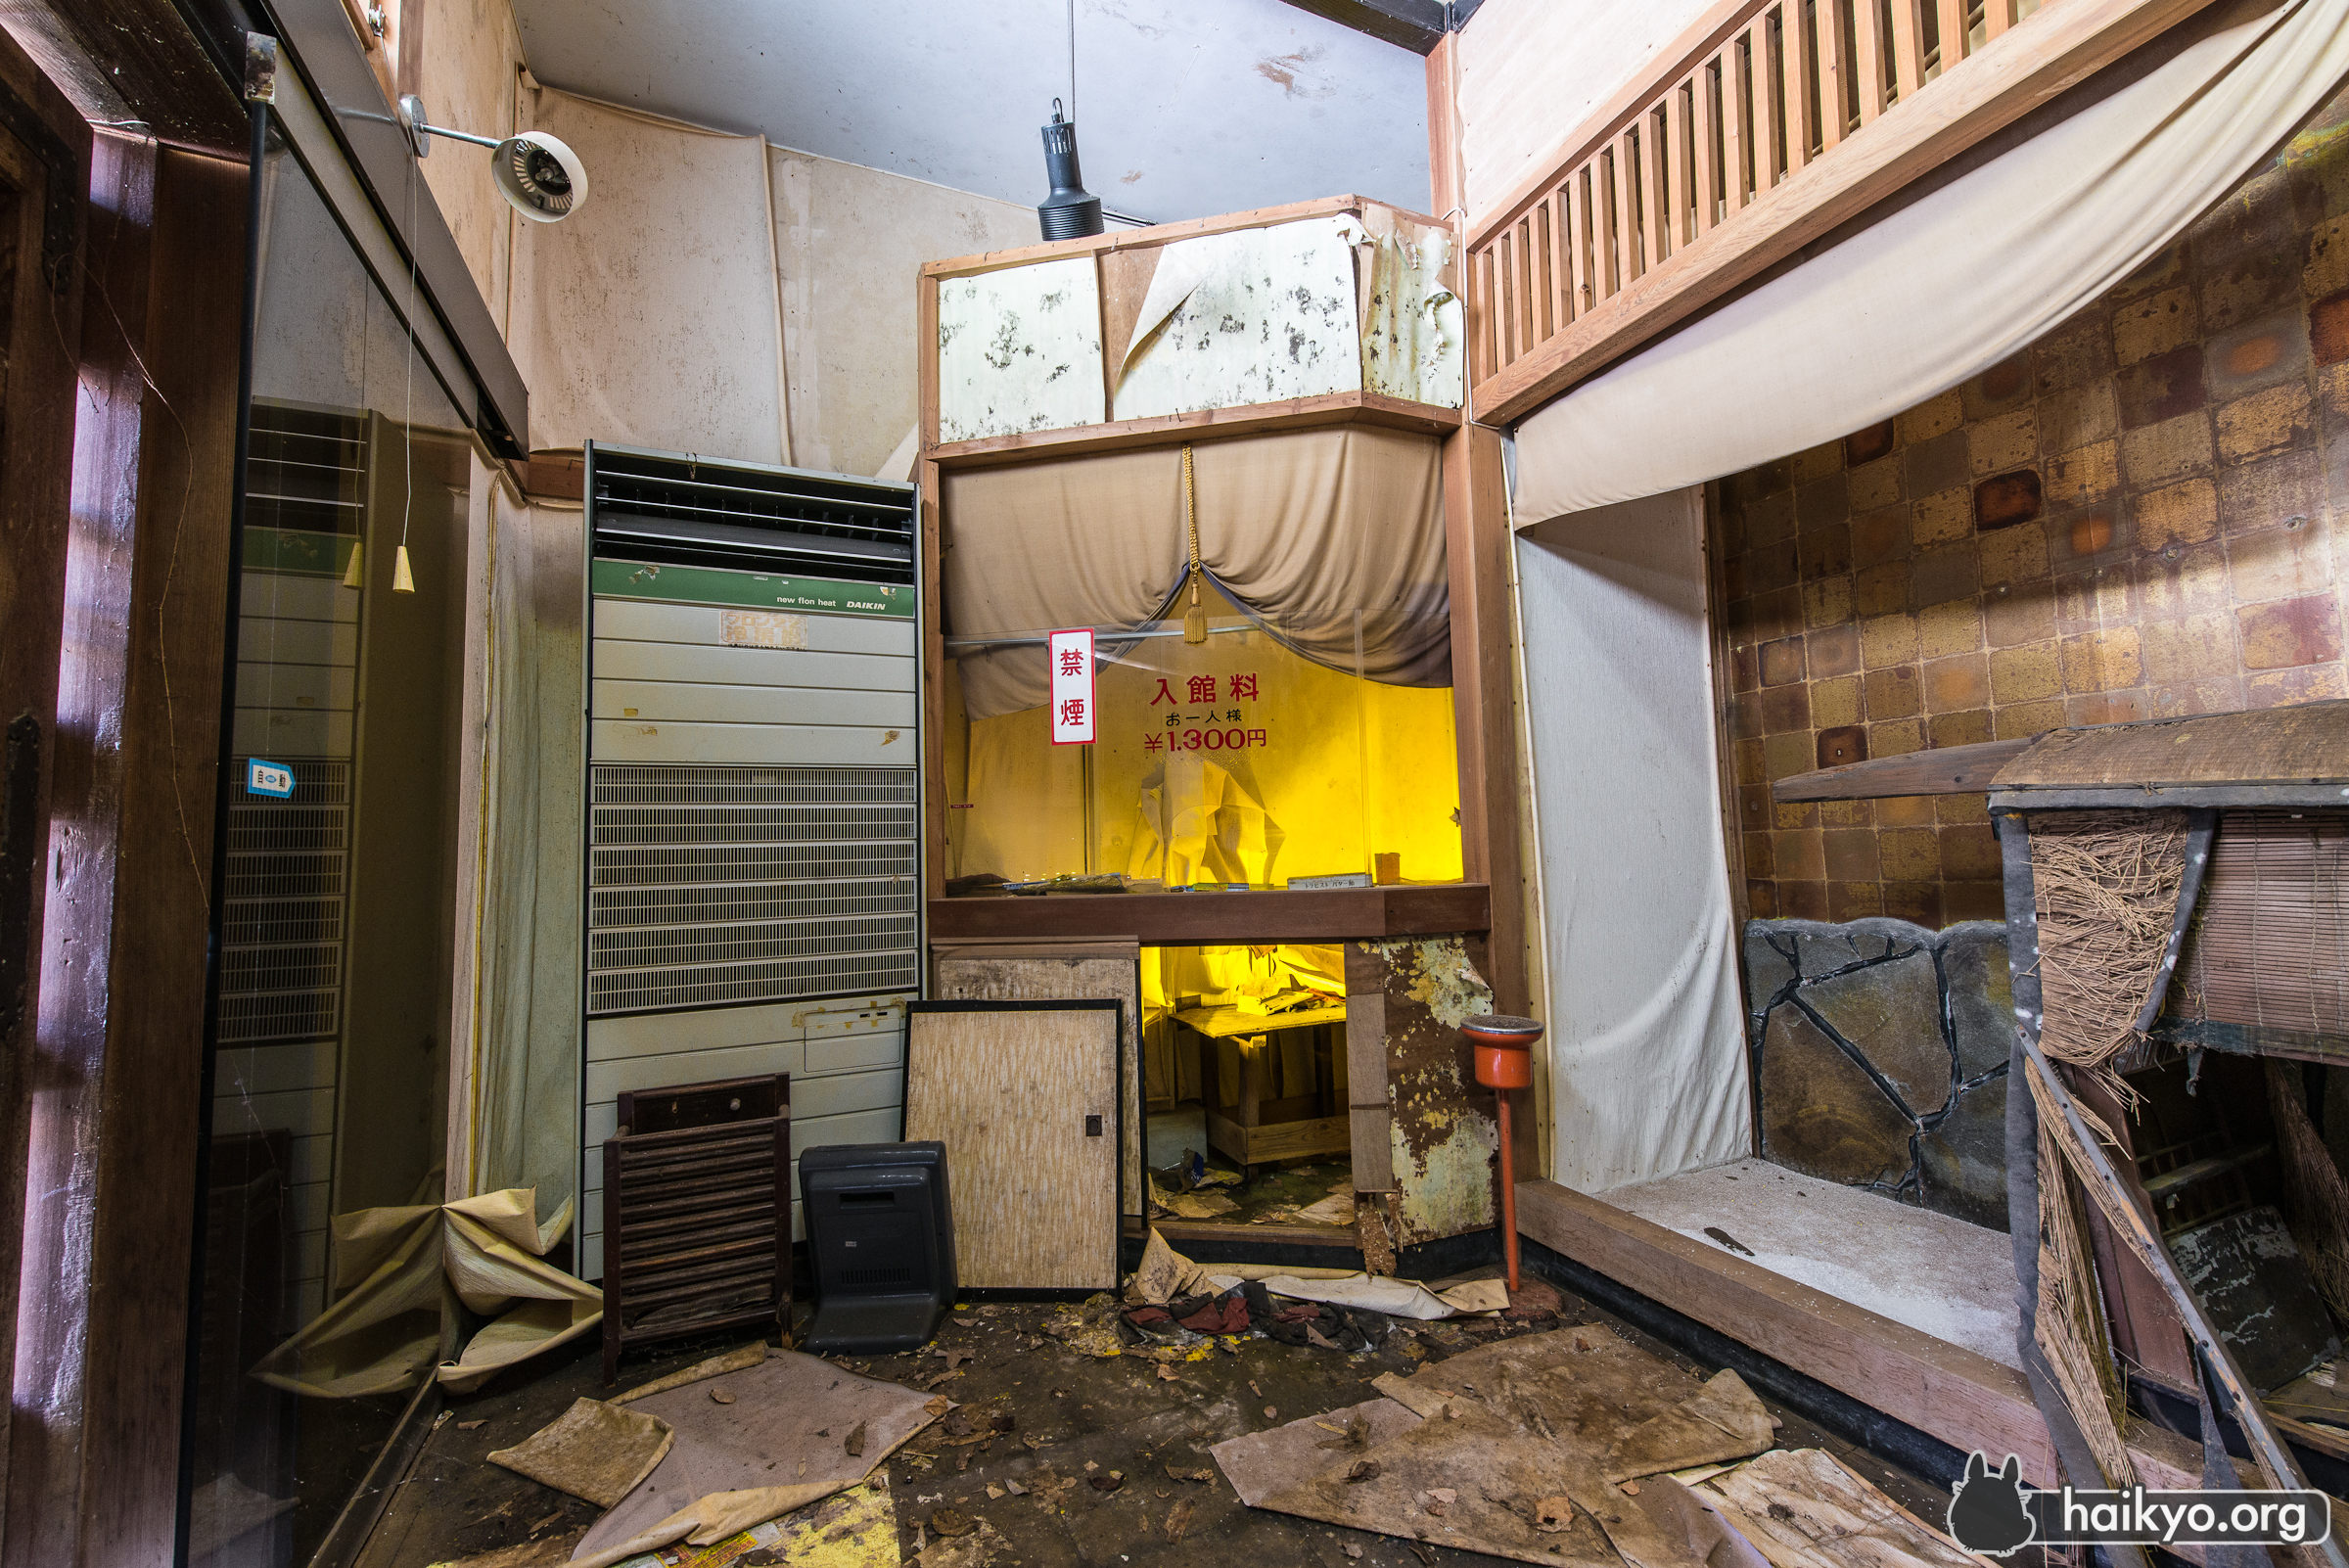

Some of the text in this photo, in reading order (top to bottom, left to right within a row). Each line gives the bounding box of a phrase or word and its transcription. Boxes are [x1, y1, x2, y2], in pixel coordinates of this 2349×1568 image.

[798, 596, 815, 605] flon
[817, 598, 837, 607] heat
[846, 600, 886, 611] DAIKIN
[1060, 648, 1084, 726] 禁煙
[1150, 672, 1259, 706] 入館料
[1166, 709, 1242, 727] お一人様
